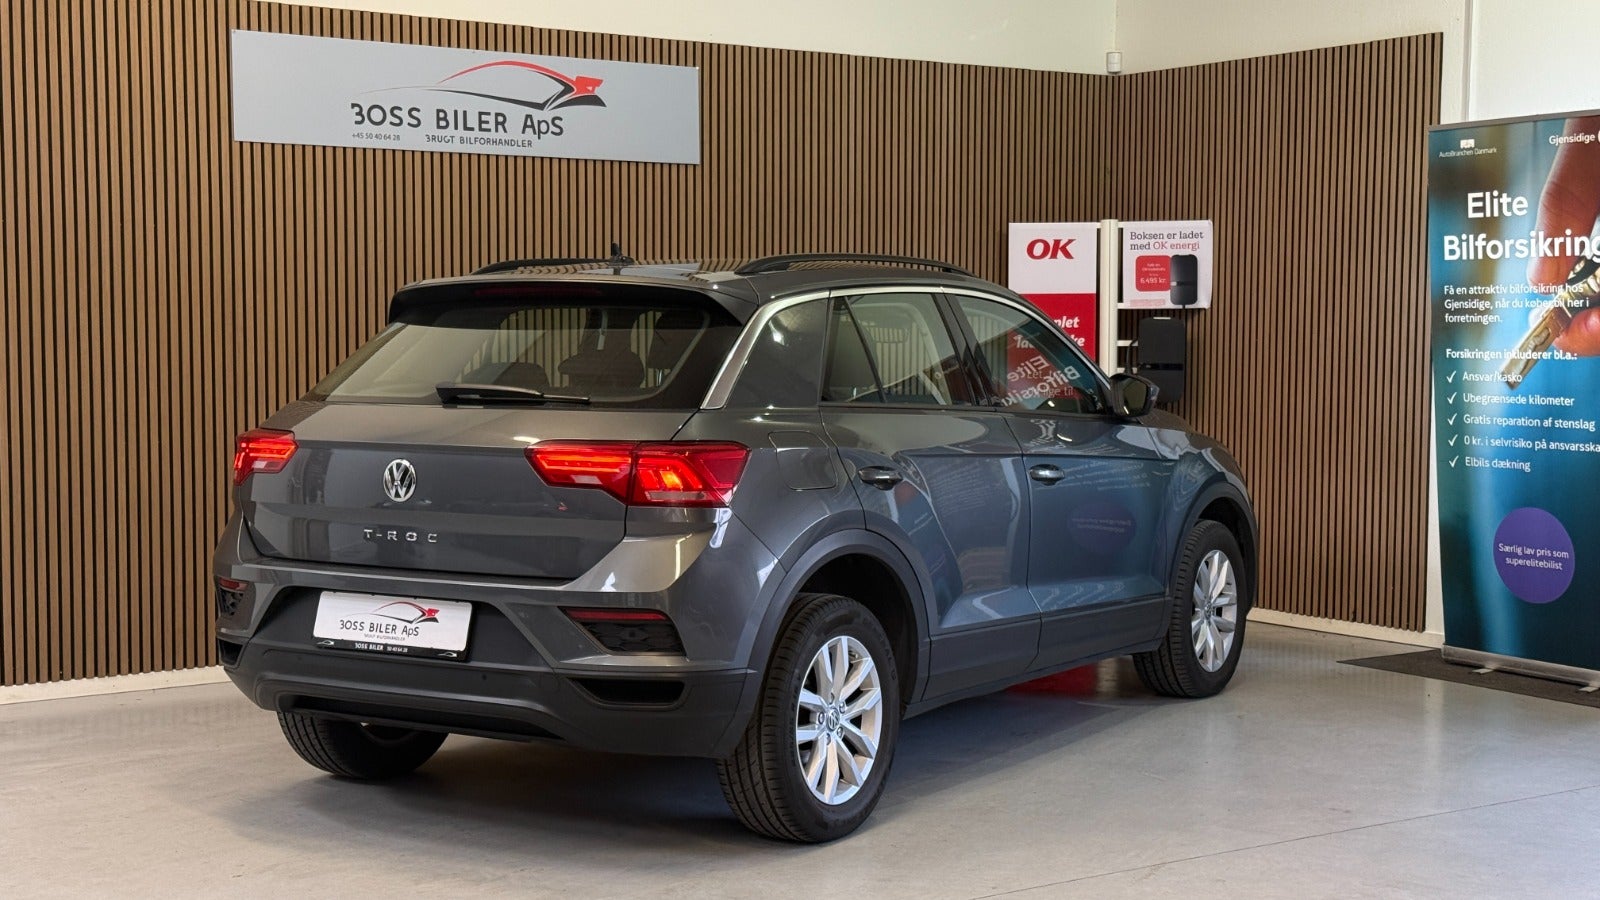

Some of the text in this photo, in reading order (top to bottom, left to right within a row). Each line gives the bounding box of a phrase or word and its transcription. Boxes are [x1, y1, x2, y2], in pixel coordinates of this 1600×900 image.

[351, 103, 564, 140] BOSS BILER ApS
[365, 132, 373, 140] 50
[383, 133, 392, 141] 64
[425, 134, 533, 148] BRUGT BILFORHANDLER
[1549, 133, 1596, 146] Gjensidige
[1438, 147, 1497, 158] AutoBranchen Danmark
[1467, 190, 1529, 219] Elite
[1130, 230, 1204, 240] Boksen er ladet
[1026, 238, 1077, 260] OK
[1130, 241, 1200, 251] med OK energi
[1444, 283, 1584, 297] Få en attraktiv bilforsikring hos
[1444, 299, 1493, 311] Gjensidige,
[1495, 298, 1510, 309] når
[1511, 298, 1523, 308] du
[1567, 297, 1584, 308] her
[1586, 297, 1590, 308] i
[1445, 313, 1503, 325] forretningen.
[1446, 348, 1578, 361] Forsikringen inkluderer bl.a.:
[1462, 371, 1523, 383] Ansvar/kasko
[1463, 393, 1575, 407] Ubegrænsede kilometer
[1463, 414, 1596, 432] Gratis reparation af stenslag
[1464, 436, 1470, 445] 0
[1472, 436, 1483, 446] kr.
[1485, 437, 1489, 446] i
[1490, 437, 1533, 449] selvrisiko
[1534, 439, 1547, 451] på
[1465, 456, 1531, 472] Elbils dækning
[363, 528, 438, 543] T-ROC
[1498, 543, 1569, 559] Særlig lav pris som
[1505, 557, 1563, 570] superelitebilist
[369, 621, 397, 635] BILER
[401, 625, 420, 638] ApS
[369, 643, 384, 651] BILER
